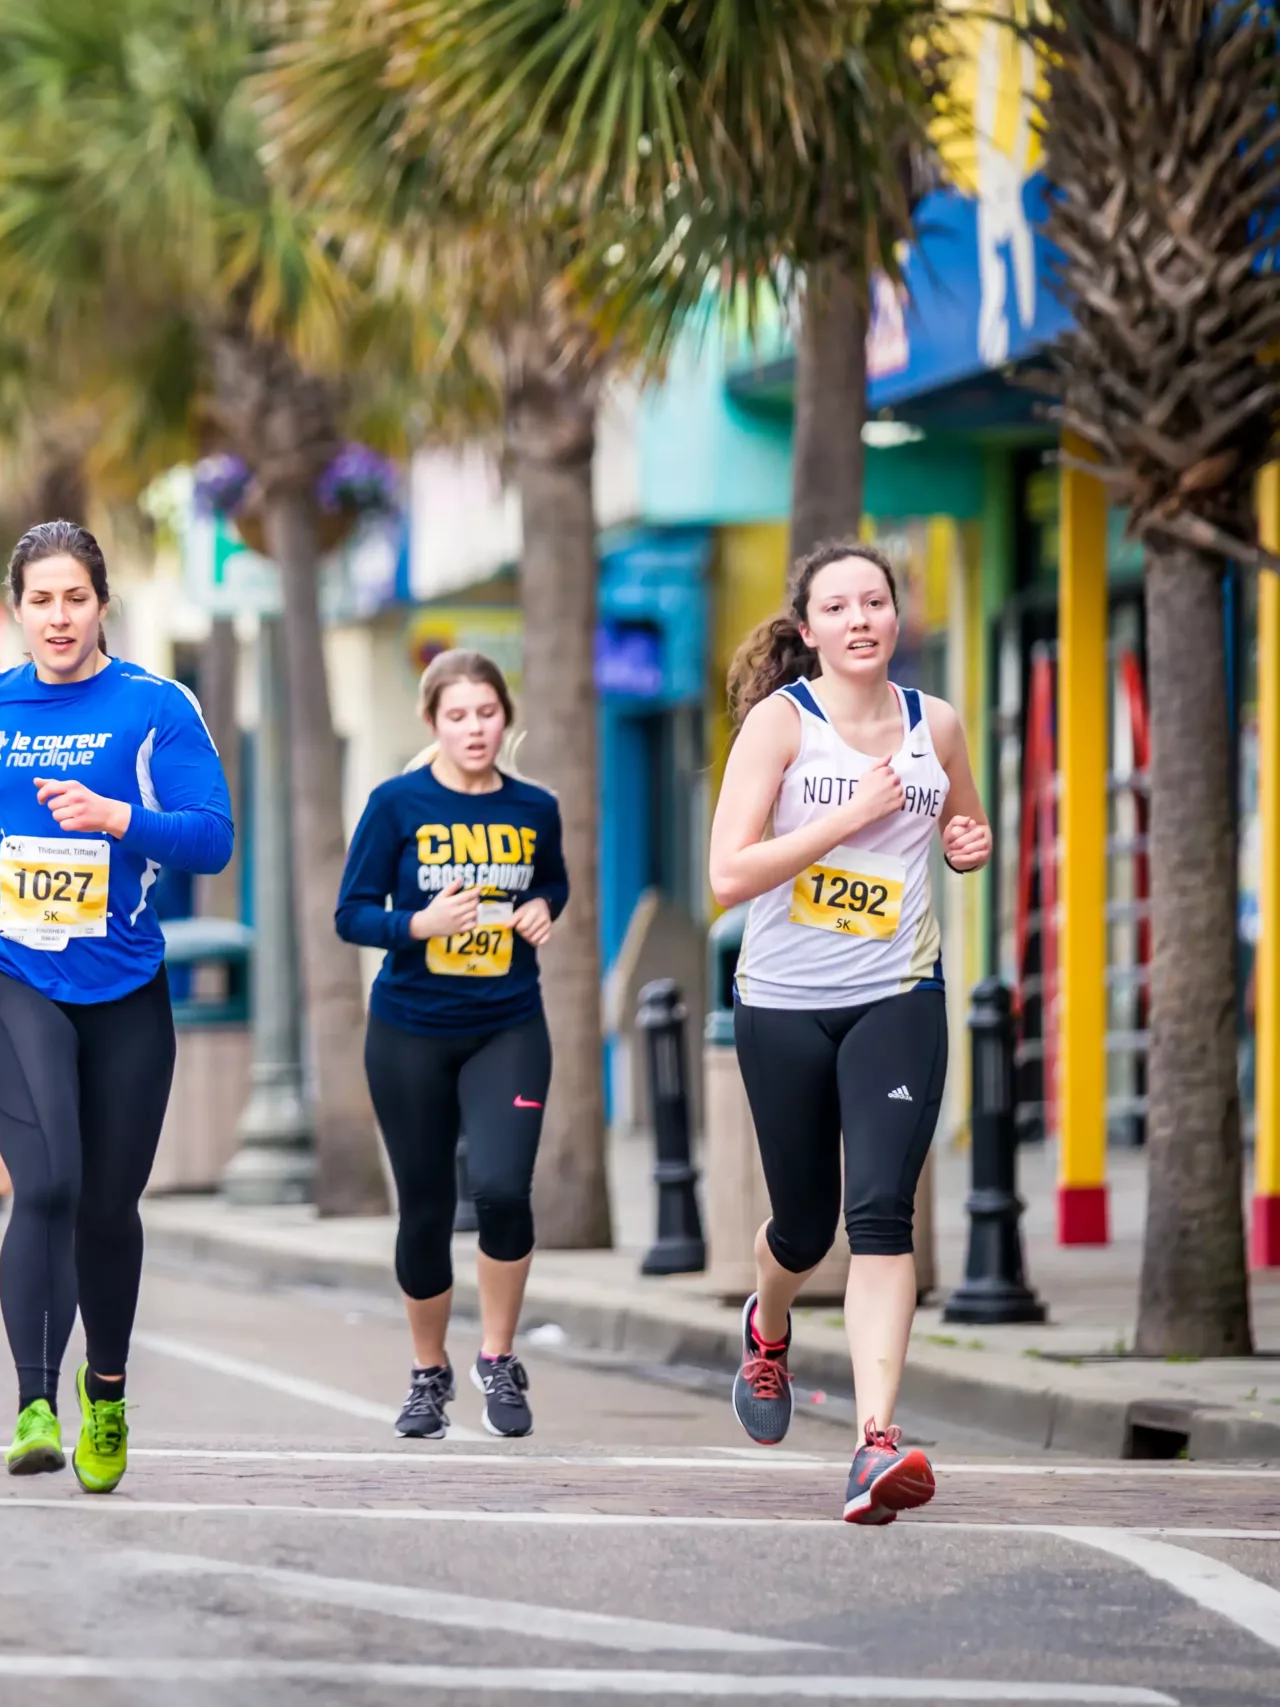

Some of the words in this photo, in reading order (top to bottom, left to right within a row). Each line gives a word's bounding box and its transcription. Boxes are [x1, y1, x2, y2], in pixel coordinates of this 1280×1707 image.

[11, 730, 31, 750] le
[32, 733, 113, 751] coureur
[6, 748, 95, 772] nordique
[900, 785, 941, 817] AME
[73, 847, 98, 858] Tiffany
[14, 868, 94, 903] 1027
[417, 863, 476, 892] CROSS
[811, 872, 888, 917] 1292
[43, 910, 60, 922] 5K
[835, 917, 851, 931] 5K
[445, 930, 503, 956] 1297
